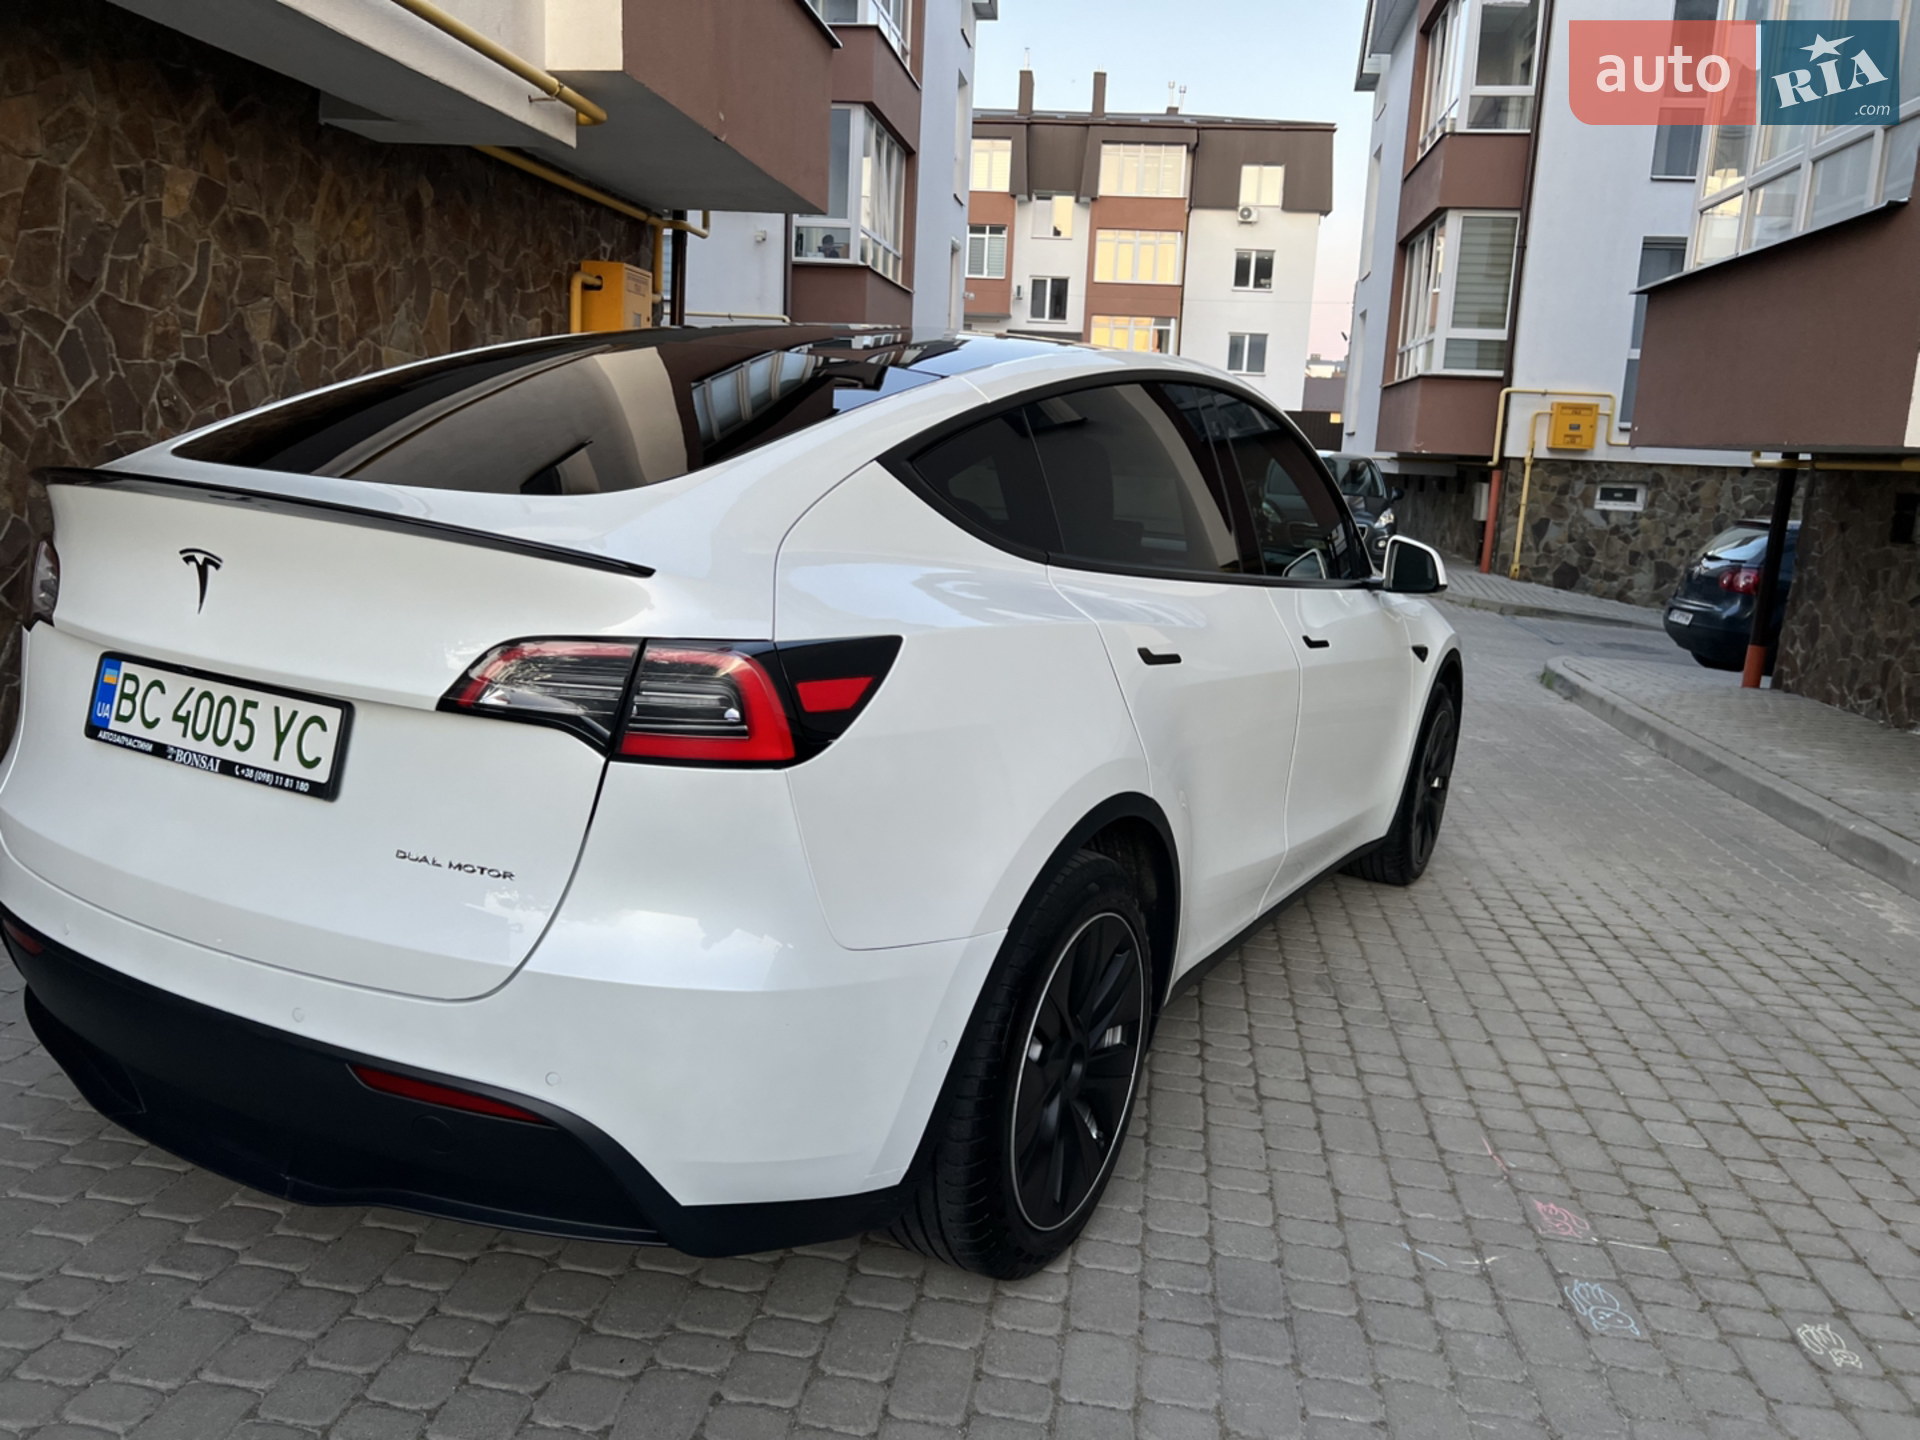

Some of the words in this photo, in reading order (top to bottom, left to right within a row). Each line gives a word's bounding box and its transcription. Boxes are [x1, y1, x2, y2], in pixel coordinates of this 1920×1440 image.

[96, 702, 111, 719] UA
[114, 673, 166, 729] BC
[172, 687, 259, 752] 4005
[273, 705, 328, 769] YC
[175, 749, 220, 773] BONSAI
[395, 849, 443, 868] DUAL
[448, 860, 515, 881] MOTOR
